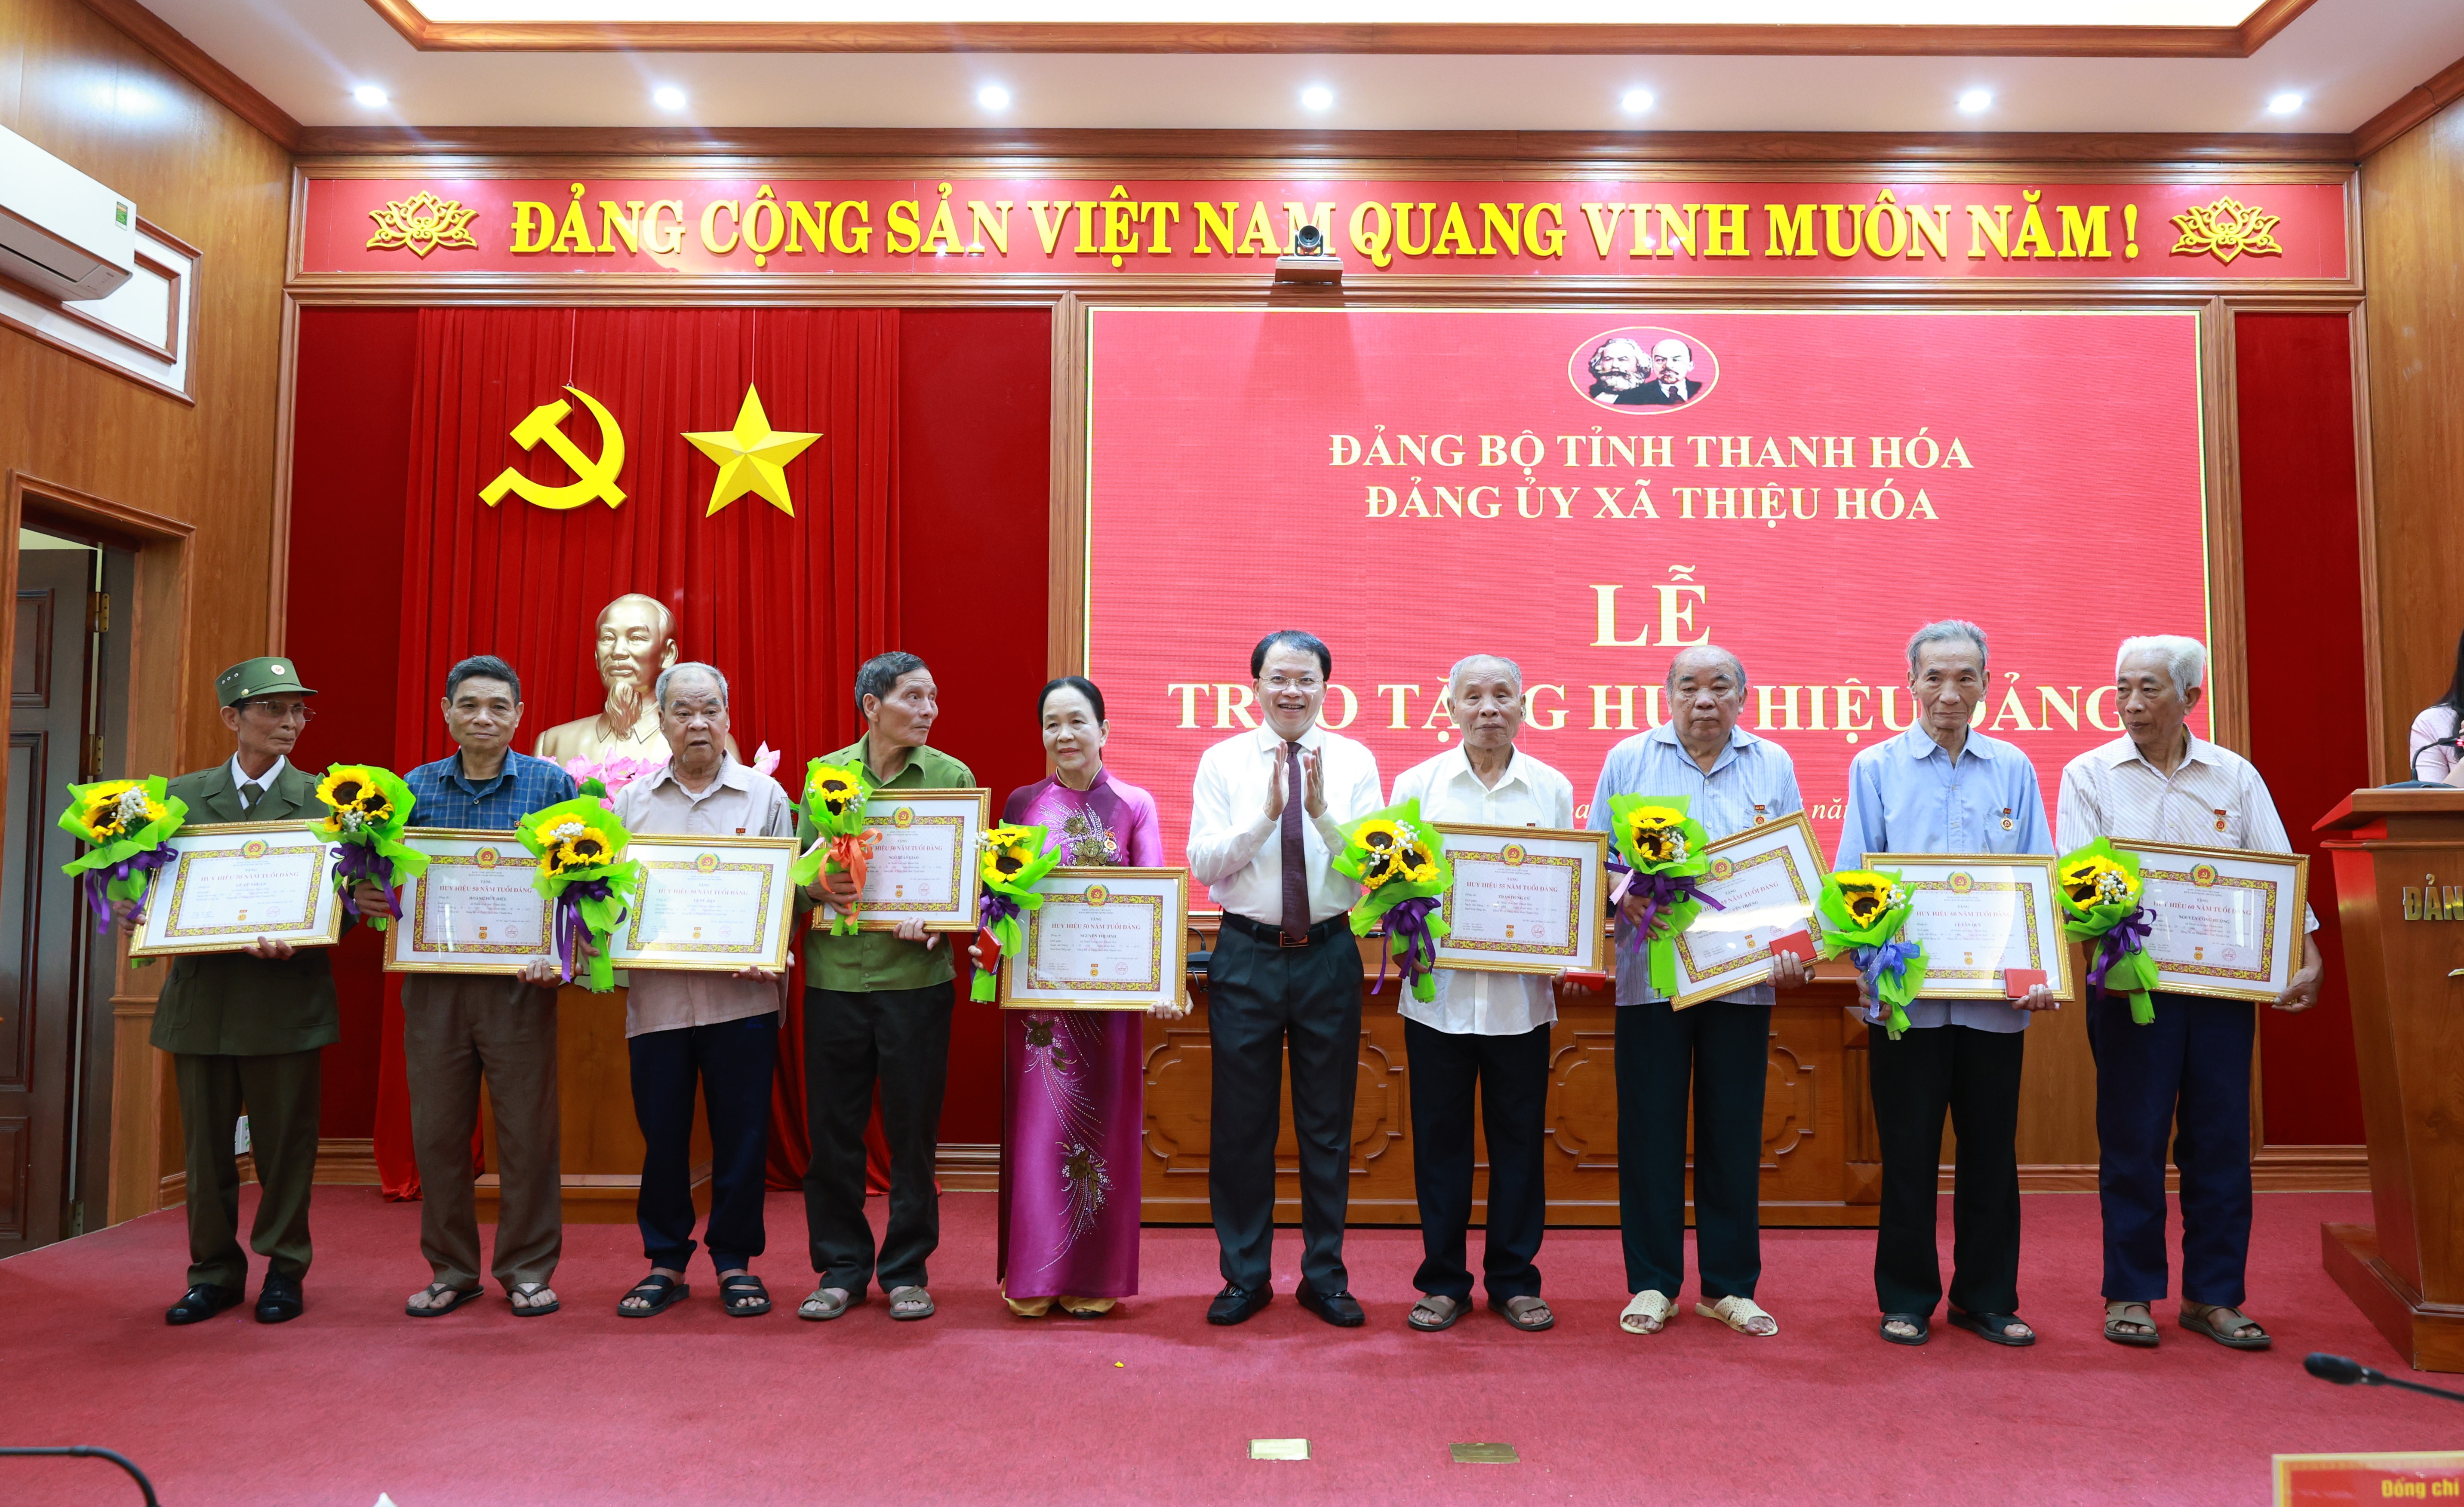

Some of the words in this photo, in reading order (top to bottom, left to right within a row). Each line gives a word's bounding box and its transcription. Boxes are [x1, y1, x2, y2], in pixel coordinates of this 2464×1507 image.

[510, 183, 687, 253] ĐẢNG
[701, 184, 873, 267] CỘNG
[887, 182, 1012, 253] SẢN
[1027, 185, 1179, 267] VIỆT
[1194, 201, 1336, 254] NAM
[1349, 201, 1567, 267] QUANG
[1582, 204, 1750, 256] VINH
[1764, 188, 1950, 257] MUÔN
[1967, 190, 2112, 257] NĂM
[1329, 424, 1466, 467] ĐẢNG
[1478, 430, 1545, 476] BỘ
[1557, 425, 1675, 467] TỈNH
[1687, 436, 1857, 468] THANH
[1868, 427, 1974, 468] HÓA
[1365, 476, 1502, 519] ĐẢNG
[1514, 476, 1581, 519] ỦY
[1593, 479, 1661, 519] XÃ
[1672, 479, 1821, 528] THIỆU
[1833, 478, 1940, 520] HÓA
[1589, 565, 1710, 646] LỄ
[1168, 684, 1358, 730] TRO
[1378, 676, 1569, 743] TẶG
[1588, 684, 1668, 730] HU
[1753, 678, 1919, 744] HIỆU
[1728, 893, 1743, 903] NĂM
[1743, 887, 1759, 898] TUỔI
[1760, 881, 1778, 892] ĐẢNG
[2170, 902, 2186, 910] HIỆU
[2402, 873, 2464, 921] ĐẢN
[2431, 1477, 2460, 1497] chí
